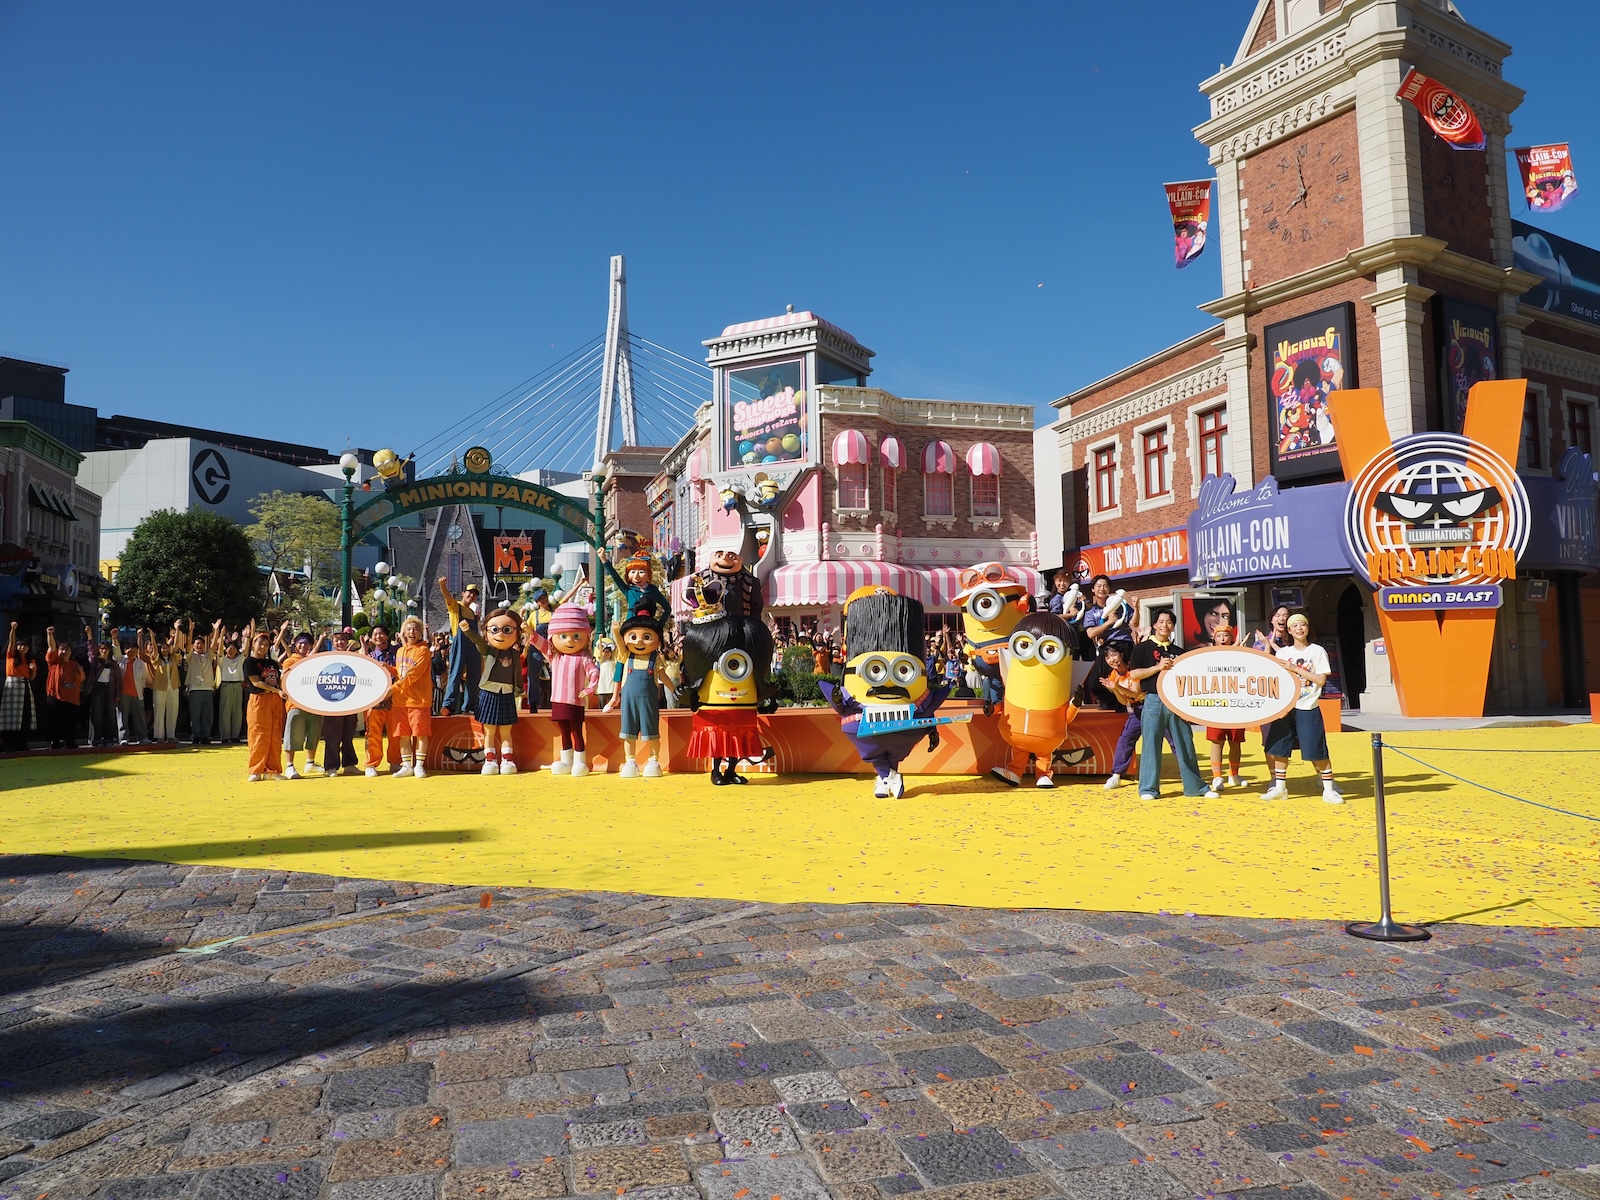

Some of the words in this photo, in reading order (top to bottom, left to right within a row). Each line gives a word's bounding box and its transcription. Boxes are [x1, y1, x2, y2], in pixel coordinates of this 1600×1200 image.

[1519, 151, 1568, 163] VILLAIN-CON
[1167, 189, 1210, 202] VILLAIN-CON
[1571, 302, 1584, 315] Shot
[1585, 309, 1592, 317] on
[734, 386, 795, 422] Sweet
[734, 405, 797, 431] SURRENDER
[735, 429, 765, 441] CANDIES
[771, 418, 798, 430] TREATS
[399, 482, 487, 508] MINION
[491, 483, 555, 511] PARK
[1199, 479, 1251, 521] Welcome
[1256, 482, 1273, 501] to
[1196, 516, 1290, 562] VILLAIN-CON
[1409, 529, 1471, 541] ILLUMINATION'S
[1103, 546, 1122, 572] THIS
[1125, 543, 1143, 568] WAY
[1146, 540, 1158, 565] TO
[1162, 535, 1183, 563] EVIL
[1365, 548, 1517, 583] VILLAIN-CON
[1445, 591, 1493, 603] BLAST
[301, 675, 340, 686] UNIVERSAL
[341, 675, 373, 687] STUDIOS
[1175, 675, 1280, 700] VILLAIN-CON
[1230, 698, 1265, 708] BLAST
